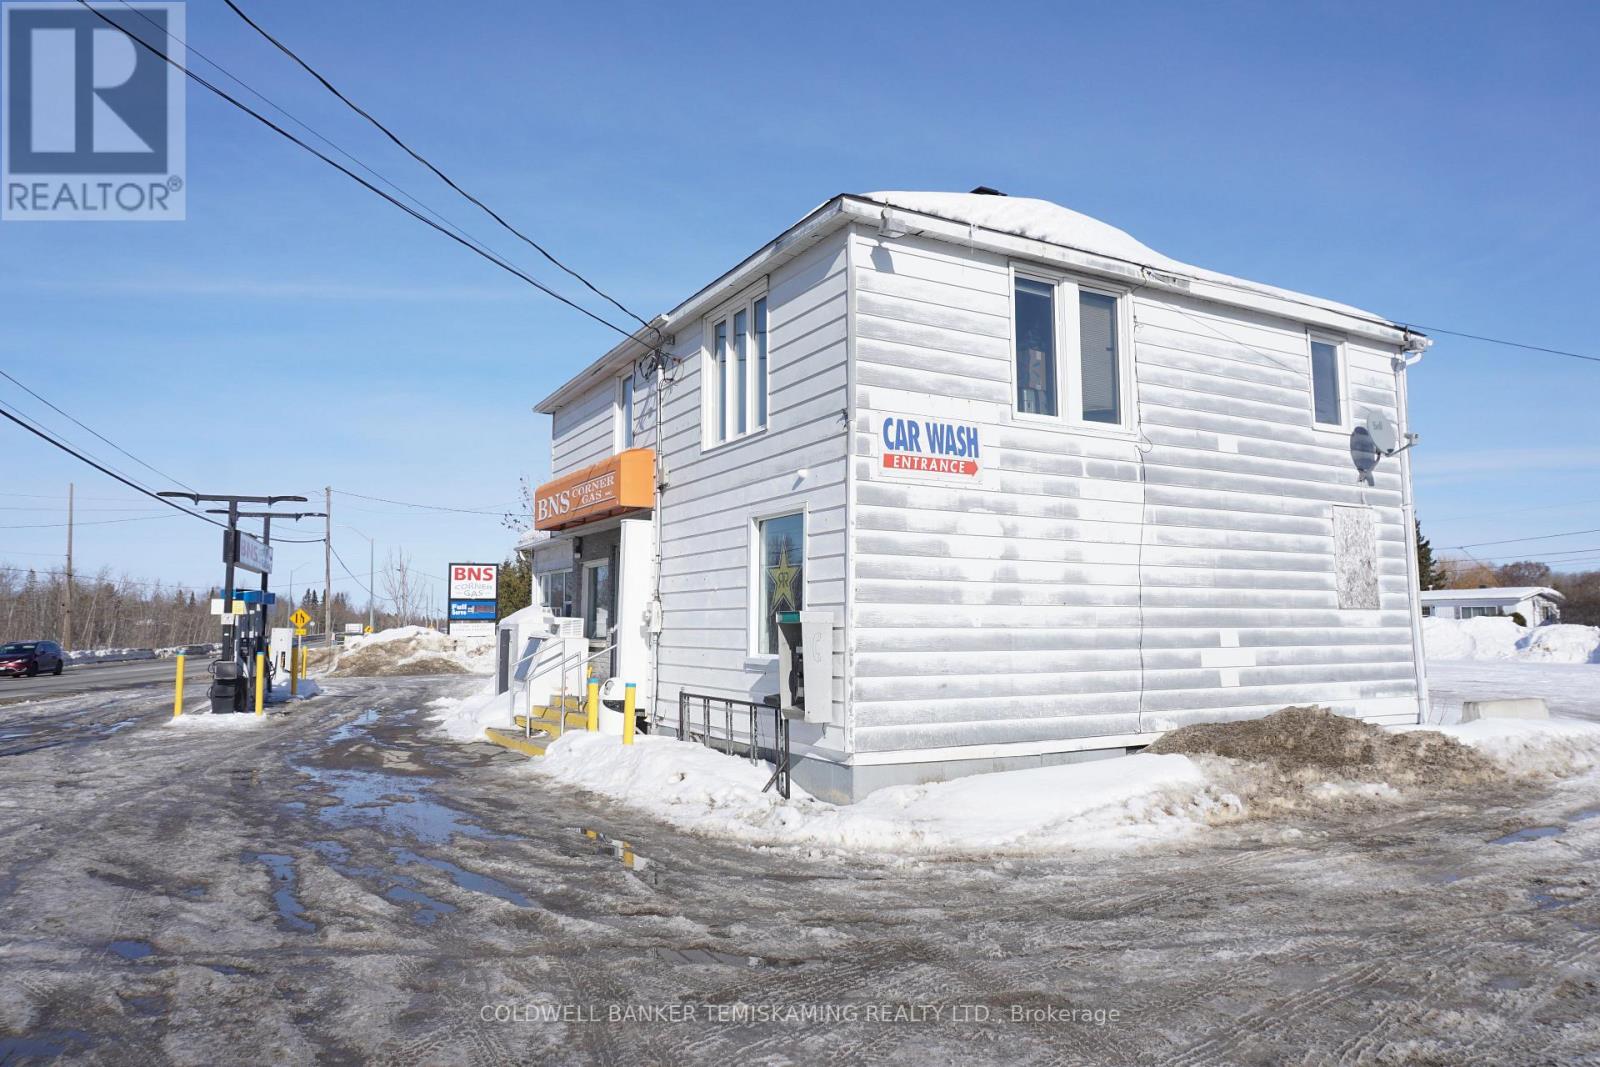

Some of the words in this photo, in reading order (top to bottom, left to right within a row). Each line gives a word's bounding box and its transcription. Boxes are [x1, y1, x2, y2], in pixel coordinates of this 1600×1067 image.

[882, 417, 922, 452] CAR
[925, 422, 979, 458] WASH
[893, 455, 965, 473] ENTRANCE
[537, 489, 569, 521] BNS
[571, 475, 615, 498] CORNER
[581, 490, 602, 505] GAS
[454, 567, 494, 581] BNS
[463, 589, 484, 597] GAS
